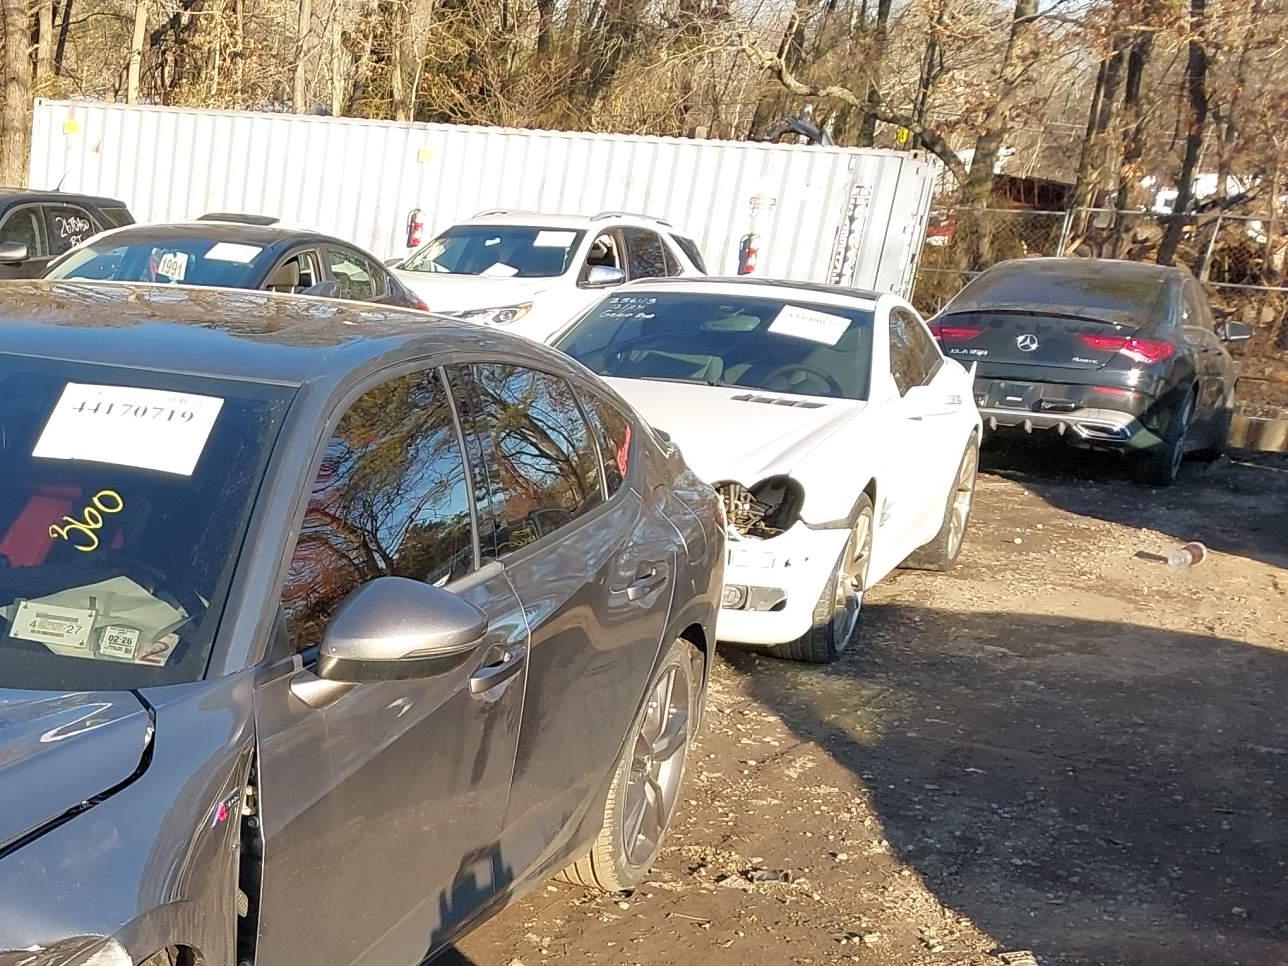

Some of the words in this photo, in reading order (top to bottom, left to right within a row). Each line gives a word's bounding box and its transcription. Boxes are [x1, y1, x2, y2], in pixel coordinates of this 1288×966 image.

[161, 257, 183, 278] 1991
[72, 401, 195, 422] 44170719
[49, 490, 124, 552] 360
